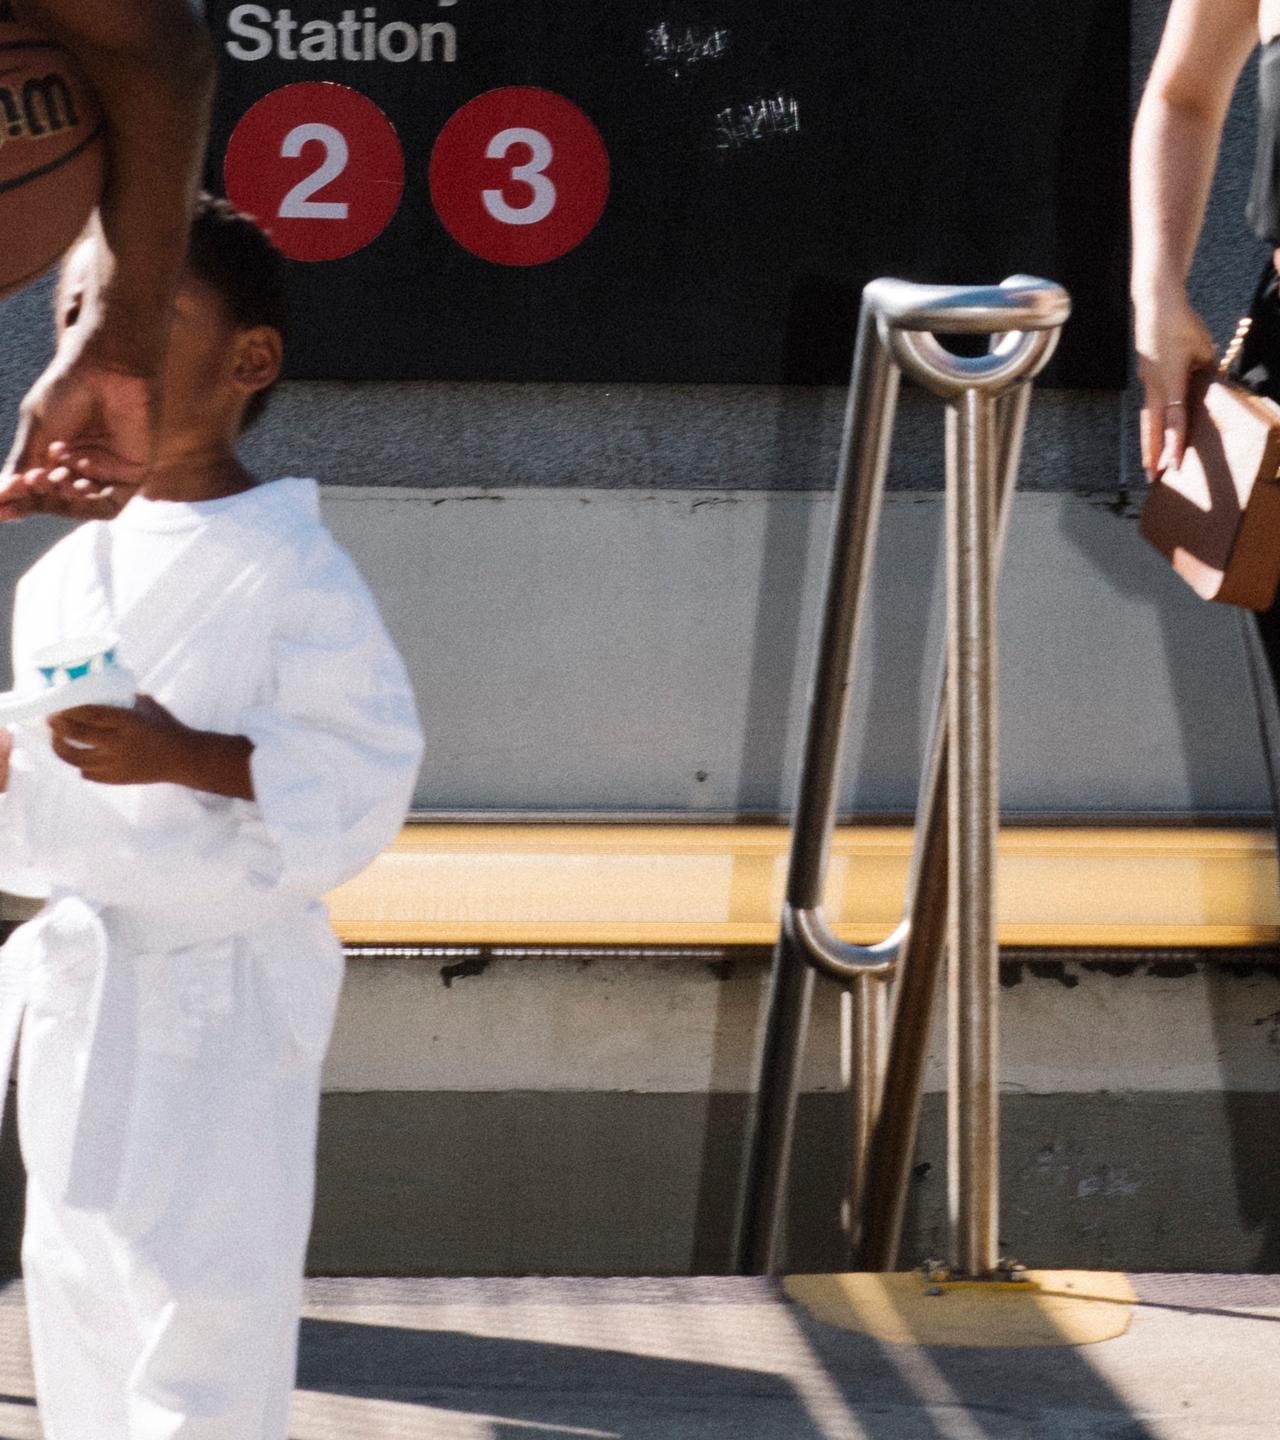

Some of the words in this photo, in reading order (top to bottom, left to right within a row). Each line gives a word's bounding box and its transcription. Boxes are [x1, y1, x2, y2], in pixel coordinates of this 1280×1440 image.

[225, 4, 458, 63] Station
[277, 122, 350, 221] 2
[480, 127, 558, 227] 3
